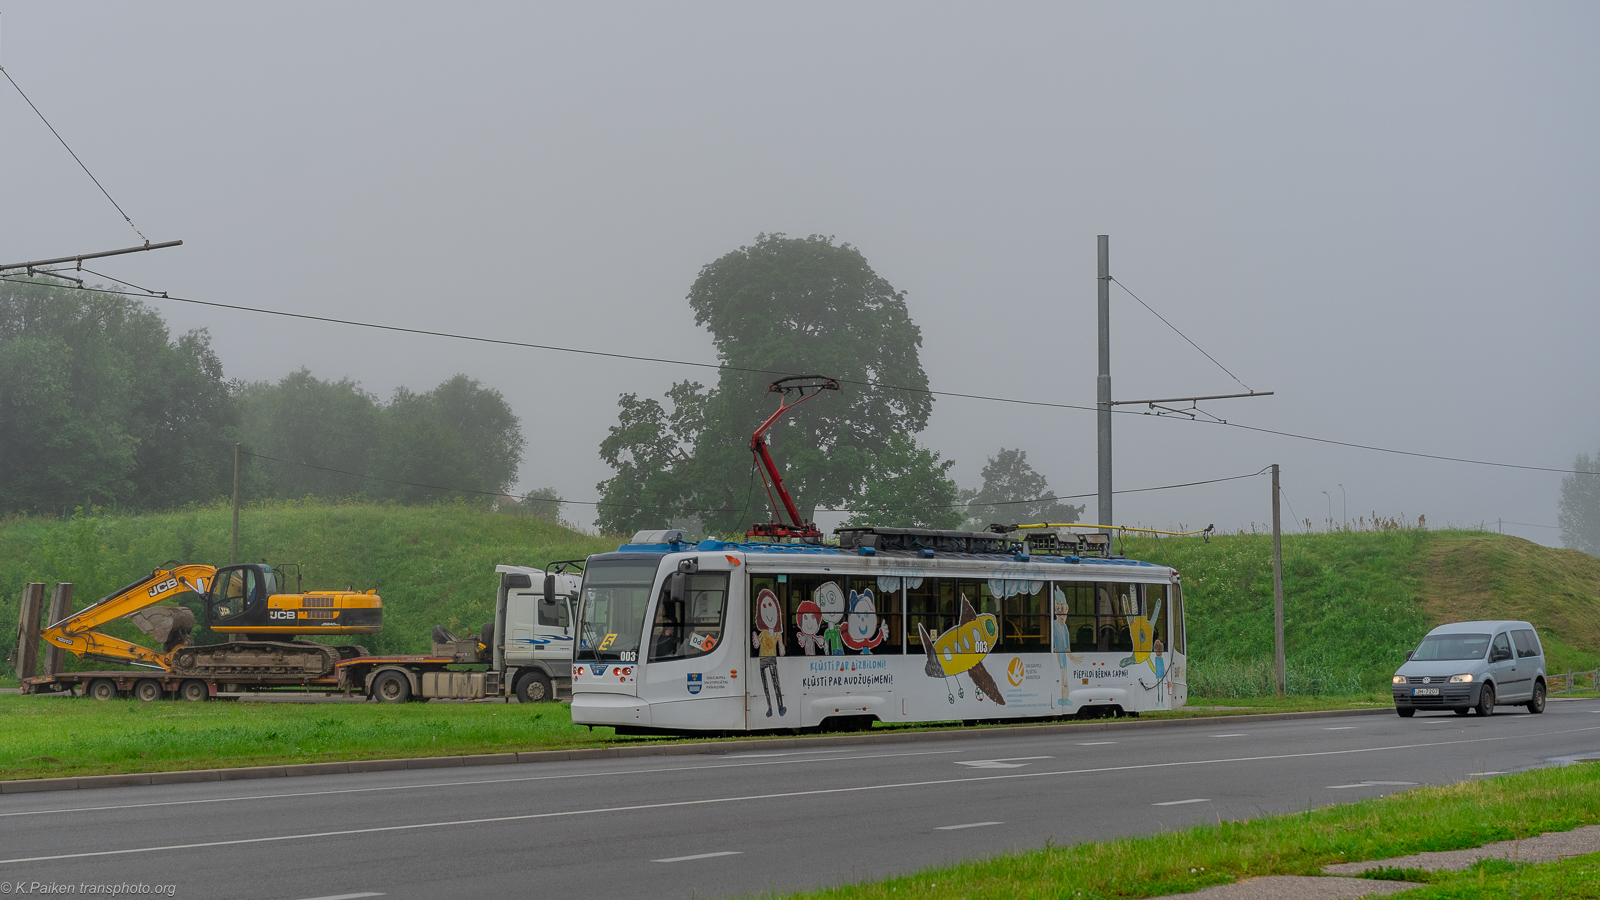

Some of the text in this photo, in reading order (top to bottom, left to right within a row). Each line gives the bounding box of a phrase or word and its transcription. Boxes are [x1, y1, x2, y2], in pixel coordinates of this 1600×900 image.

[149, 578, 178, 597] JCB
[270, 611, 295, 620] JCB
[975, 641, 988, 653] 003
[620, 651, 636, 662] 003
[836, 661, 849, 671] PAR
[1095, 667, 1111, 679] BĒRNA
[828, 676, 842, 686] PAR
